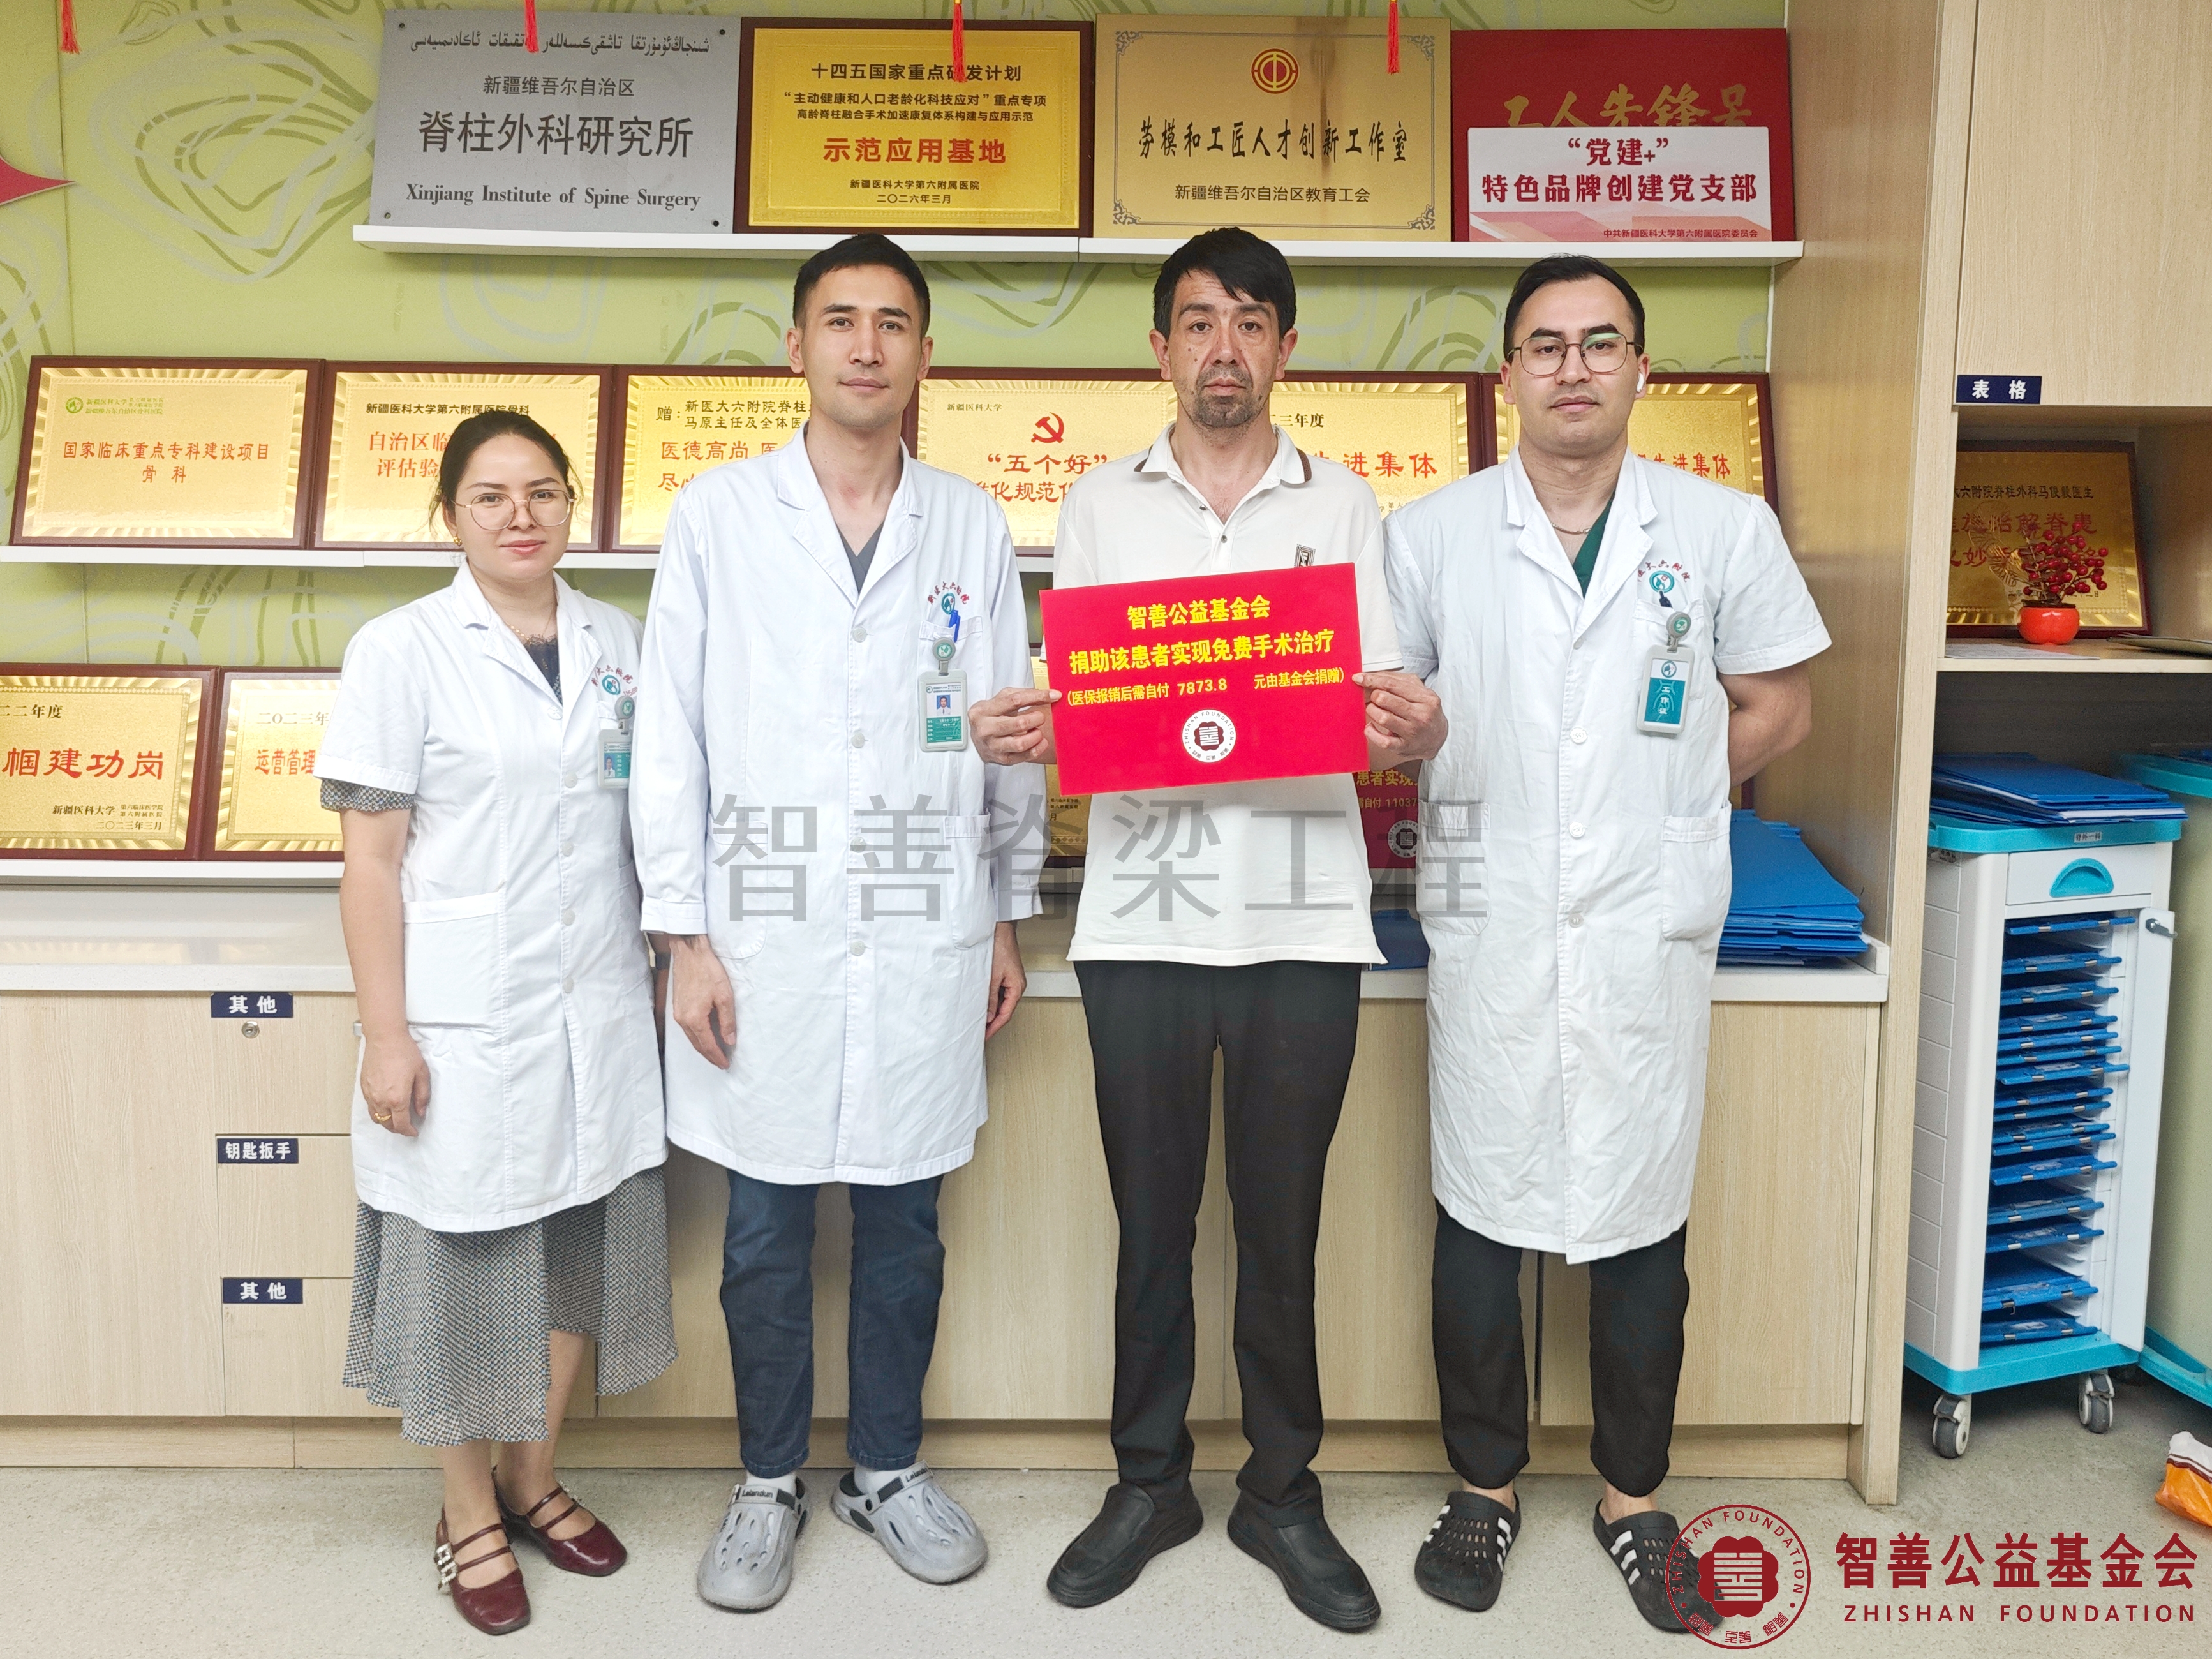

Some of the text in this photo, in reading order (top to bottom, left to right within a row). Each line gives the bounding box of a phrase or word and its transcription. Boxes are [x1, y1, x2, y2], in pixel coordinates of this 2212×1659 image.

[483, 75, 635, 97] 新疆维吾尔自治区
[796, 108, 1034, 122] 高龄脊柱融合手术加速康复体系构建与应用示范
[418, 110, 694, 158] 脊柱外科研究所
[1139, 116, 1408, 163] 劳模和工匠人才创新工作室
[823, 137, 1006, 164] 示范应用基地
[850, 179, 980, 191] 新疆医科大学第六附属医院
[1175, 184, 1370, 203] 新疆维吾尔自治区教育工会
[1481, 174, 1756, 204] 特色品牌创建党支部
[406, 183, 701, 211] Xinjiang Institute of Spine Surgery
[1603, 229, 1758, 238] 中共新疆医科大学第六附属医院委员会
[1972, 379, 2027, 400] 表格
[685, 400, 811, 413] 新医大六附院脊柱
[947, 403, 1002, 412] 新疆医科大学
[63, 441, 269, 461] 国家临床重点专科建设项目
[661, 440, 748, 461] 医德高尚
[988, 453, 1108, 475] “五个好”
[142, 465, 187, 484] 骨科
[1127, 594, 1270, 630] 智善公益基金会
[1069, 628, 1335, 675] 捐助该患者实现免费手术治疗
[1177, 678, 1228, 696] 7873.8
[1184, 711, 1235, 744] ZHISHAN FOUNDATION
[1, 747, 164, 780] 帼建功岗
[255, 748, 316, 775] 运营管理
[1356, 769, 1418, 786] 患者实现
[52, 805, 115, 815] 新疆医科大学
[229, 995, 278, 1014] 其他
[225, 1142, 292, 1160] 钥匙扳手
[240, 1282, 287, 1300] 其他
